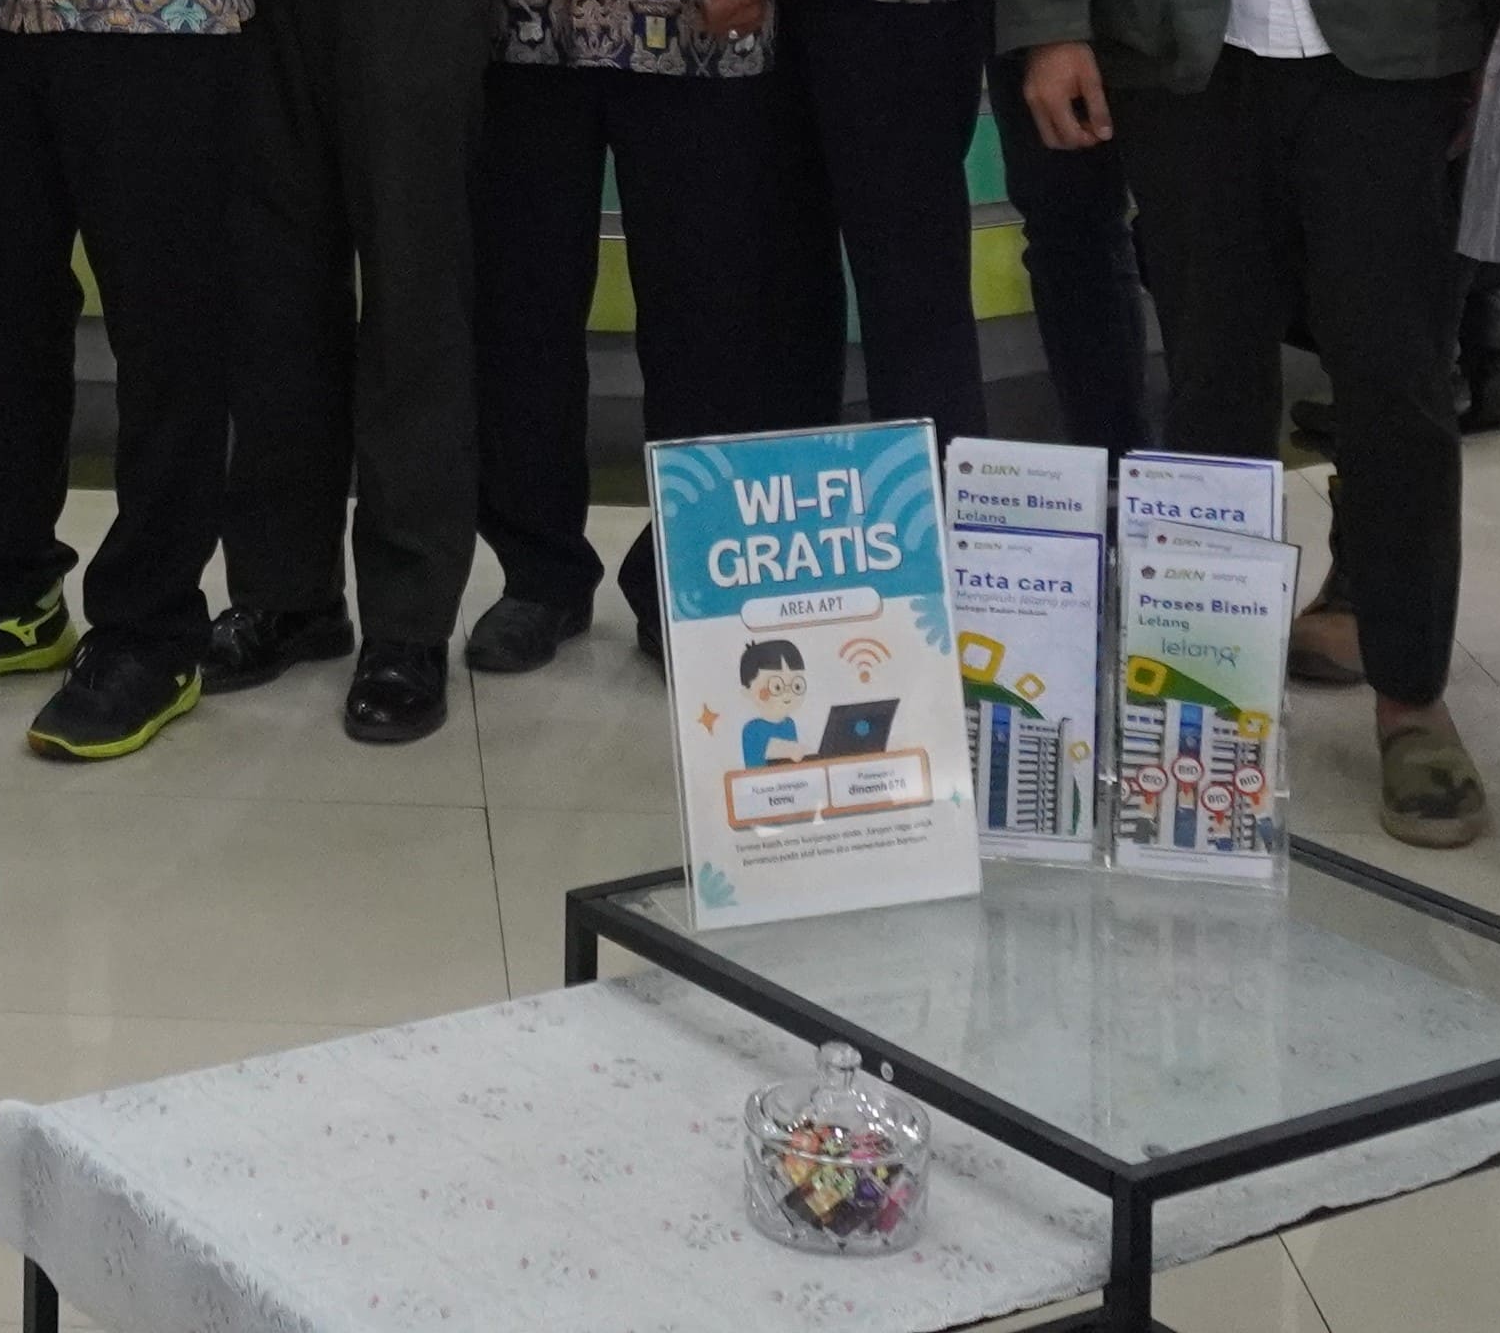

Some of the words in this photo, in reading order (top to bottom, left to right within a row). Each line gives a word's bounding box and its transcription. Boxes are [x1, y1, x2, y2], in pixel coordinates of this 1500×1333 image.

[733, 468, 865, 525] WI-FI
[958, 489, 1021, 507] Proses
[1027, 495, 1083, 512] Bisnis
[957, 509, 1007, 524] Lelang
[1126, 496, 1181, 518] Tata
[1190, 506, 1246, 523] cara
[708, 523, 902, 587] GRATIS
[955, 568, 1009, 590] Tata
[1018, 577, 1073, 594] cara
[780, 600, 815, 616] AREA
[819, 596, 844, 613] APT
[1139, 594, 1205, 612] Proses
[1211, 599, 1269, 616] Bisnis
[1138, 614, 1190, 631] Lelang
[1161, 637, 1240, 668] lelang
